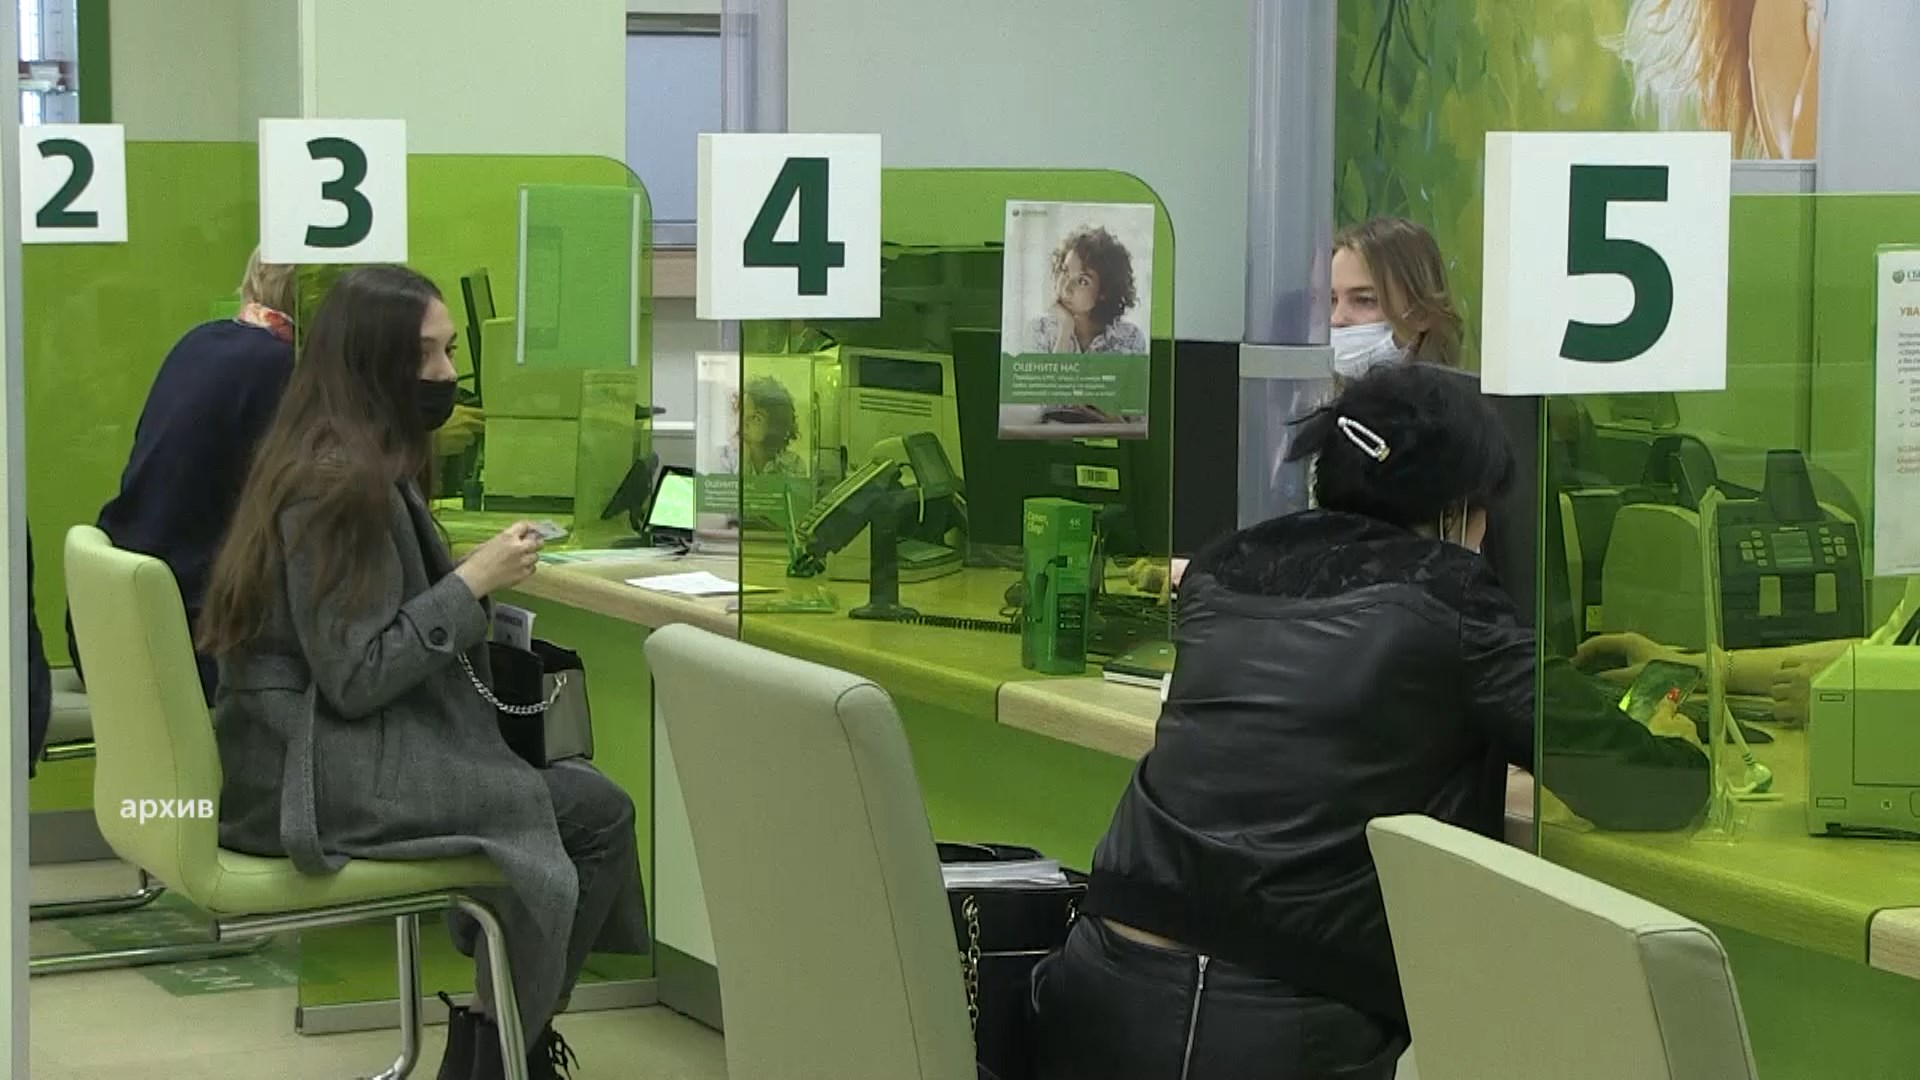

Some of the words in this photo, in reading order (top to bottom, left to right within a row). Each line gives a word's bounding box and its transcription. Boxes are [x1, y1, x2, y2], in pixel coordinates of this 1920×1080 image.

[37, 139, 98, 228] 2
[304, 137, 373, 248] 3
[743, 157, 845, 296] 4
[1559, 164, 1674, 363] 5
[1012, 363, 1059, 373] ОЦЕНИТЕ
[1060, 363, 1080, 372] НАС
